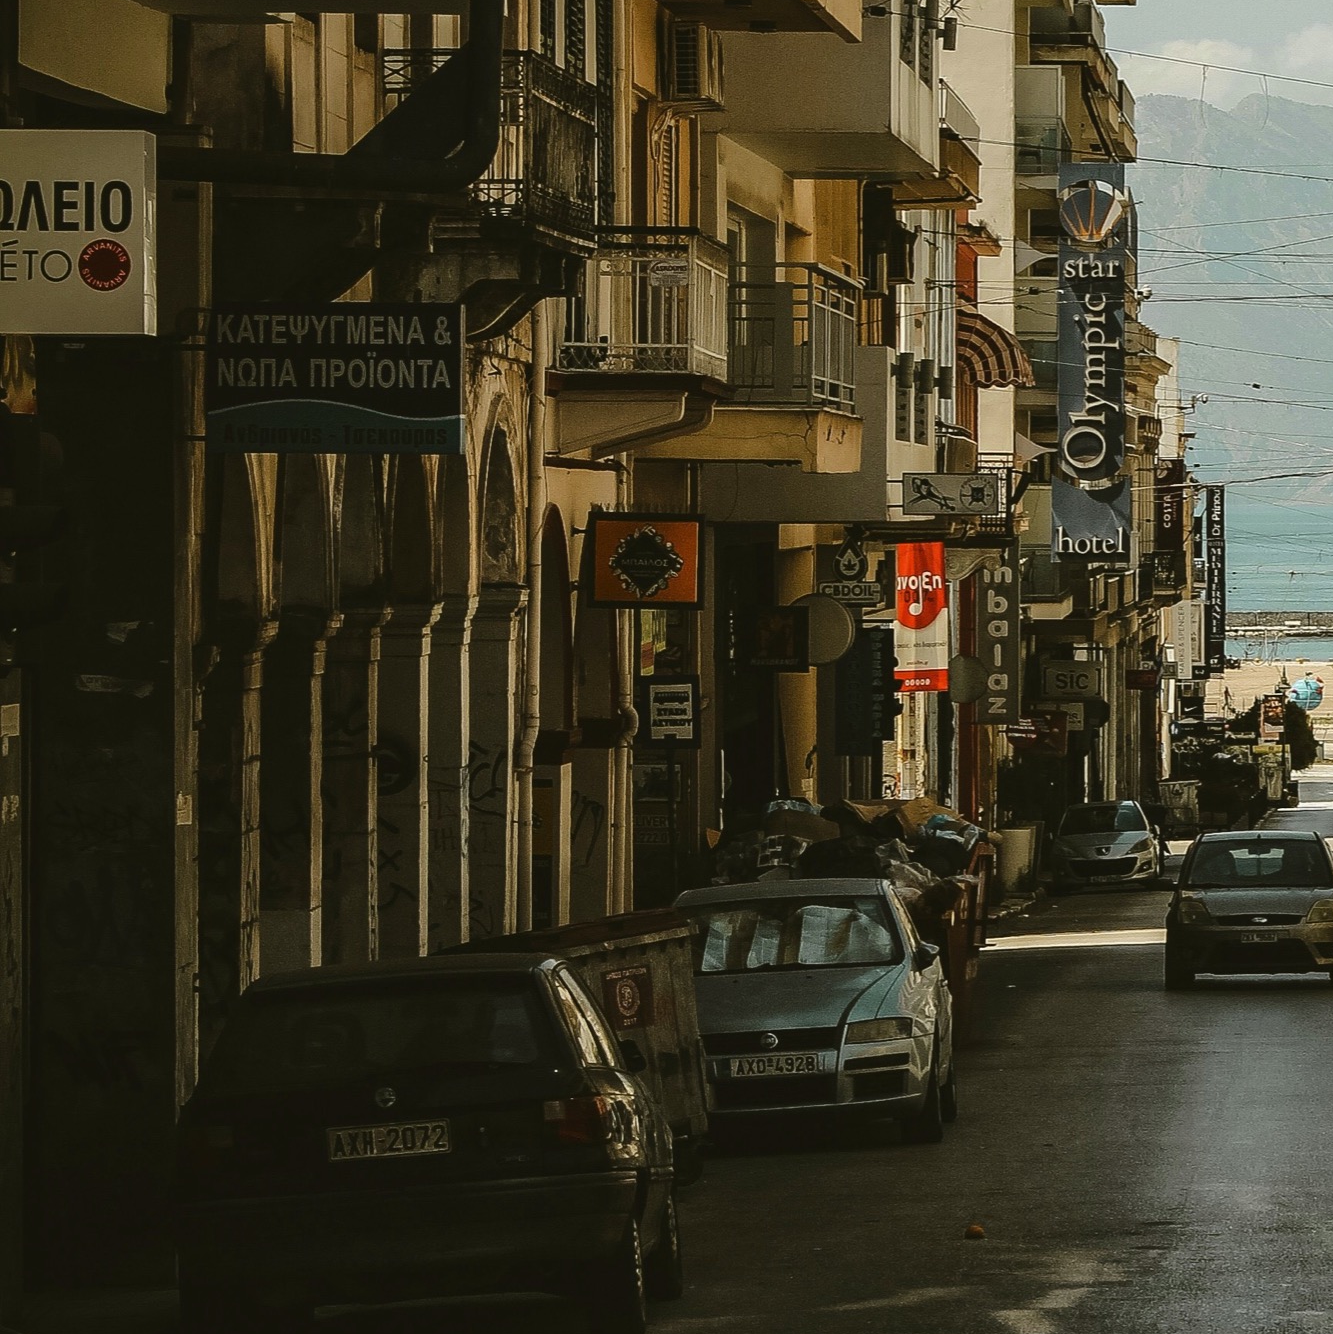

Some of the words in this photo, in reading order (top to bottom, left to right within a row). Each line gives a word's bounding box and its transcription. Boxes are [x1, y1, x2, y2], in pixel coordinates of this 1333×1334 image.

[1063, 254, 1119, 278] star
[217, 315, 425, 345] ΚΑΤΕΨΥΓΜΕΝΑ
[434, 315, 452, 345] &
[218, 358, 298, 388] ΝΩΠΑ
[309, 351, 451, 388] ΠΡΟΪΟΝΤΑ
[1064, 292, 1120, 469] Olympic
[1163, 495, 1172, 528] COSTA
[1056, 525, 1126, 555] hotel
[1211, 524, 1221, 536] Dr
